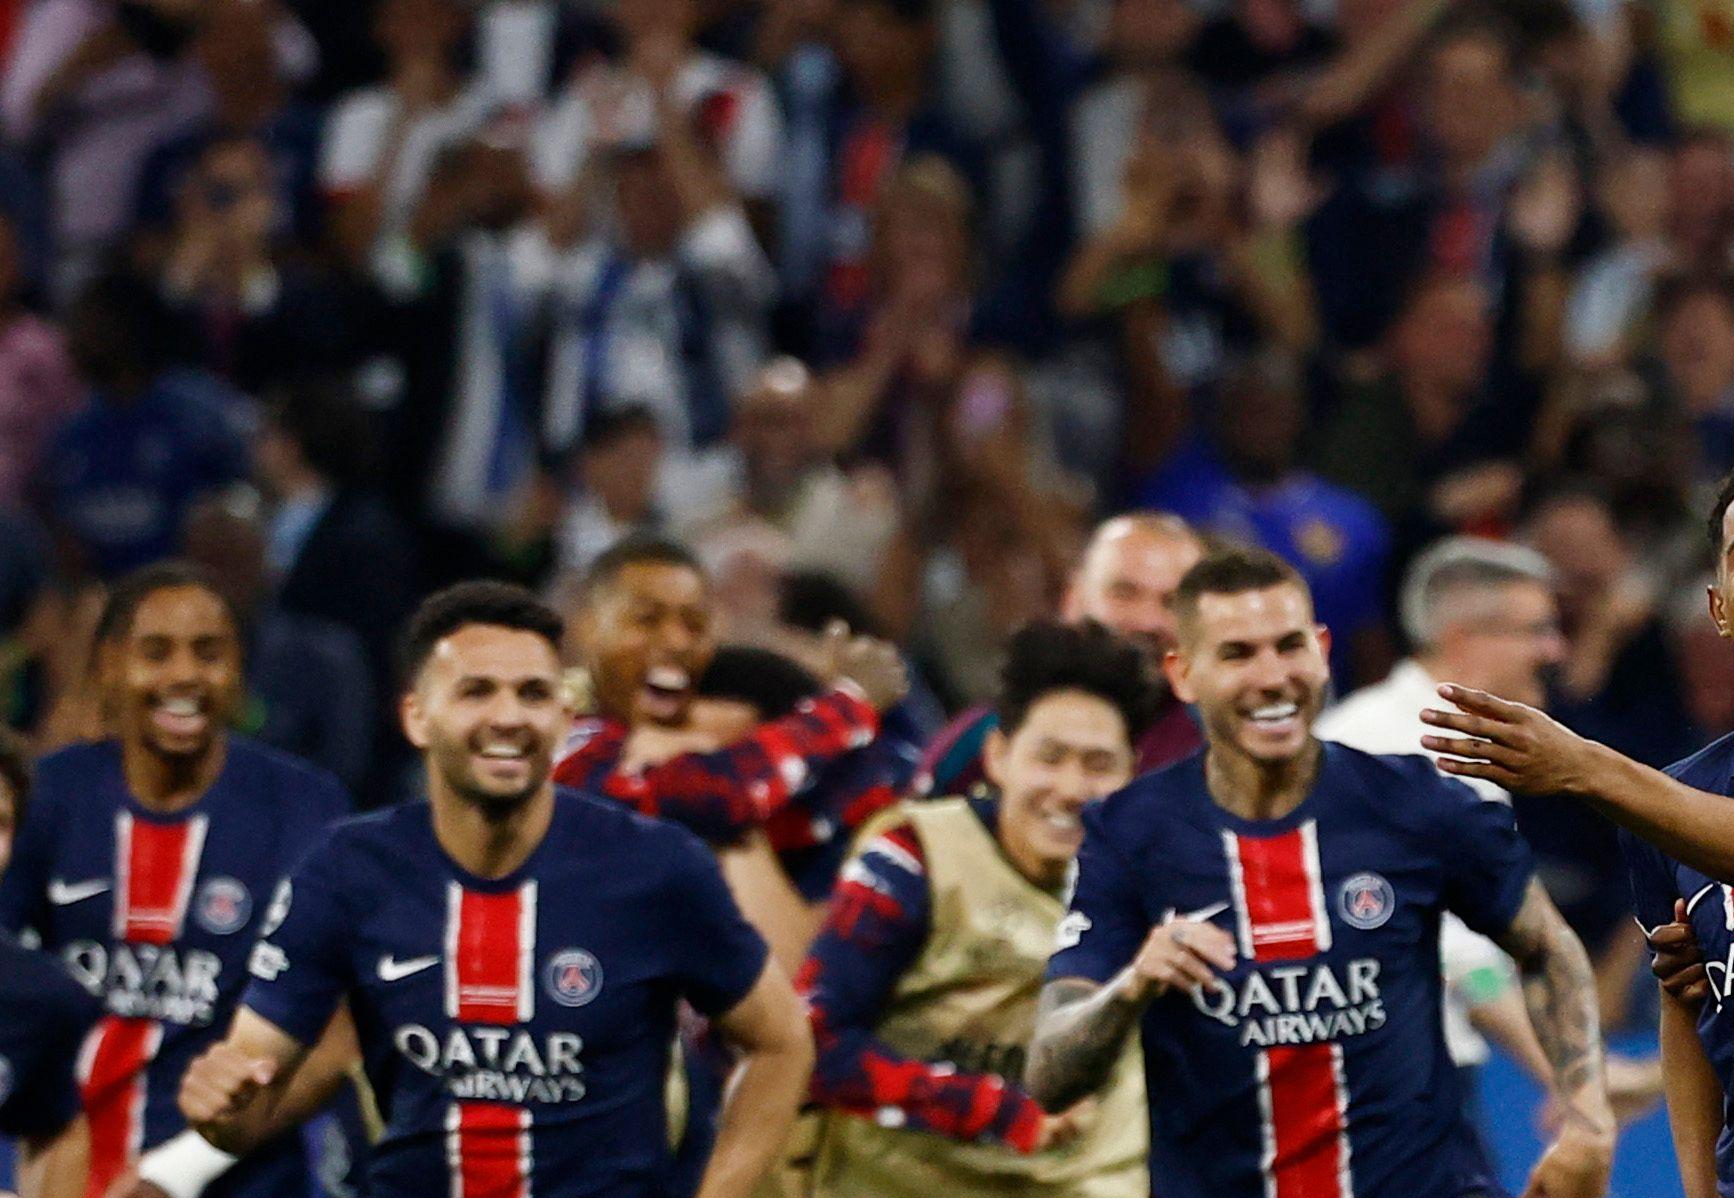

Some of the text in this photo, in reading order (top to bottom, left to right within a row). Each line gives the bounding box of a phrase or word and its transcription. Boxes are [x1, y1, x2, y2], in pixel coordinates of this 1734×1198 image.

[1189, 957, 1382, 1027] QATAR
[394, 1022, 585, 1077] QATAR
[1237, 998, 1388, 1047] AIRWAYS
